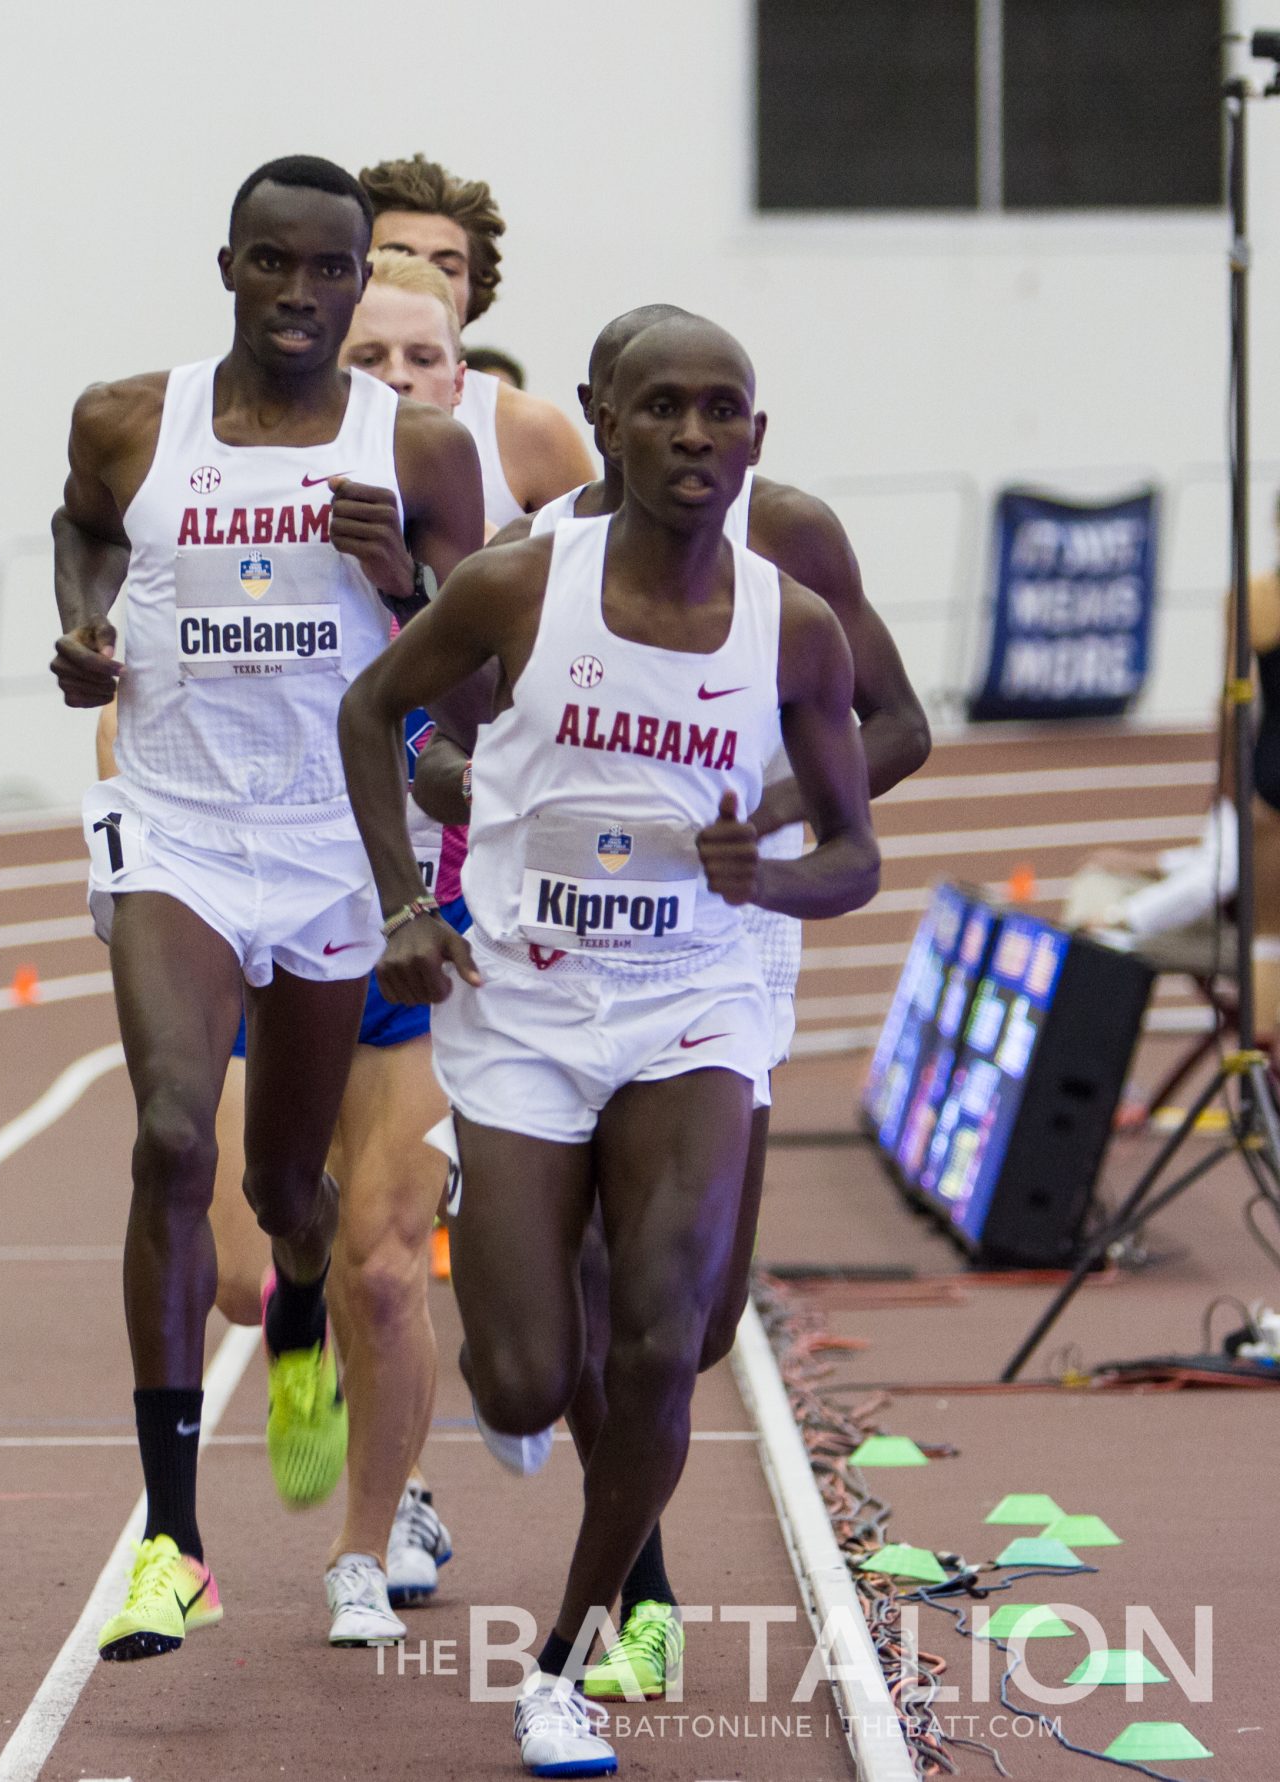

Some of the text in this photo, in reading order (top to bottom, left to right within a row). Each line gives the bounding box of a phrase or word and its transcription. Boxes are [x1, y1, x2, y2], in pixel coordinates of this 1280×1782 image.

[190, 466, 222, 494] SEC
[177, 503, 334, 545] ALABAM
[180, 616, 338, 657] Chelanga
[233, 665, 261, 674] TEXAS
[570, 655, 604, 688] SEC
[555, 703, 738, 771] ALABAMA
[92, 811, 124, 874] 1
[536, 878, 680, 937] Kiprop
[579, 938, 610, 948] TEXAS
